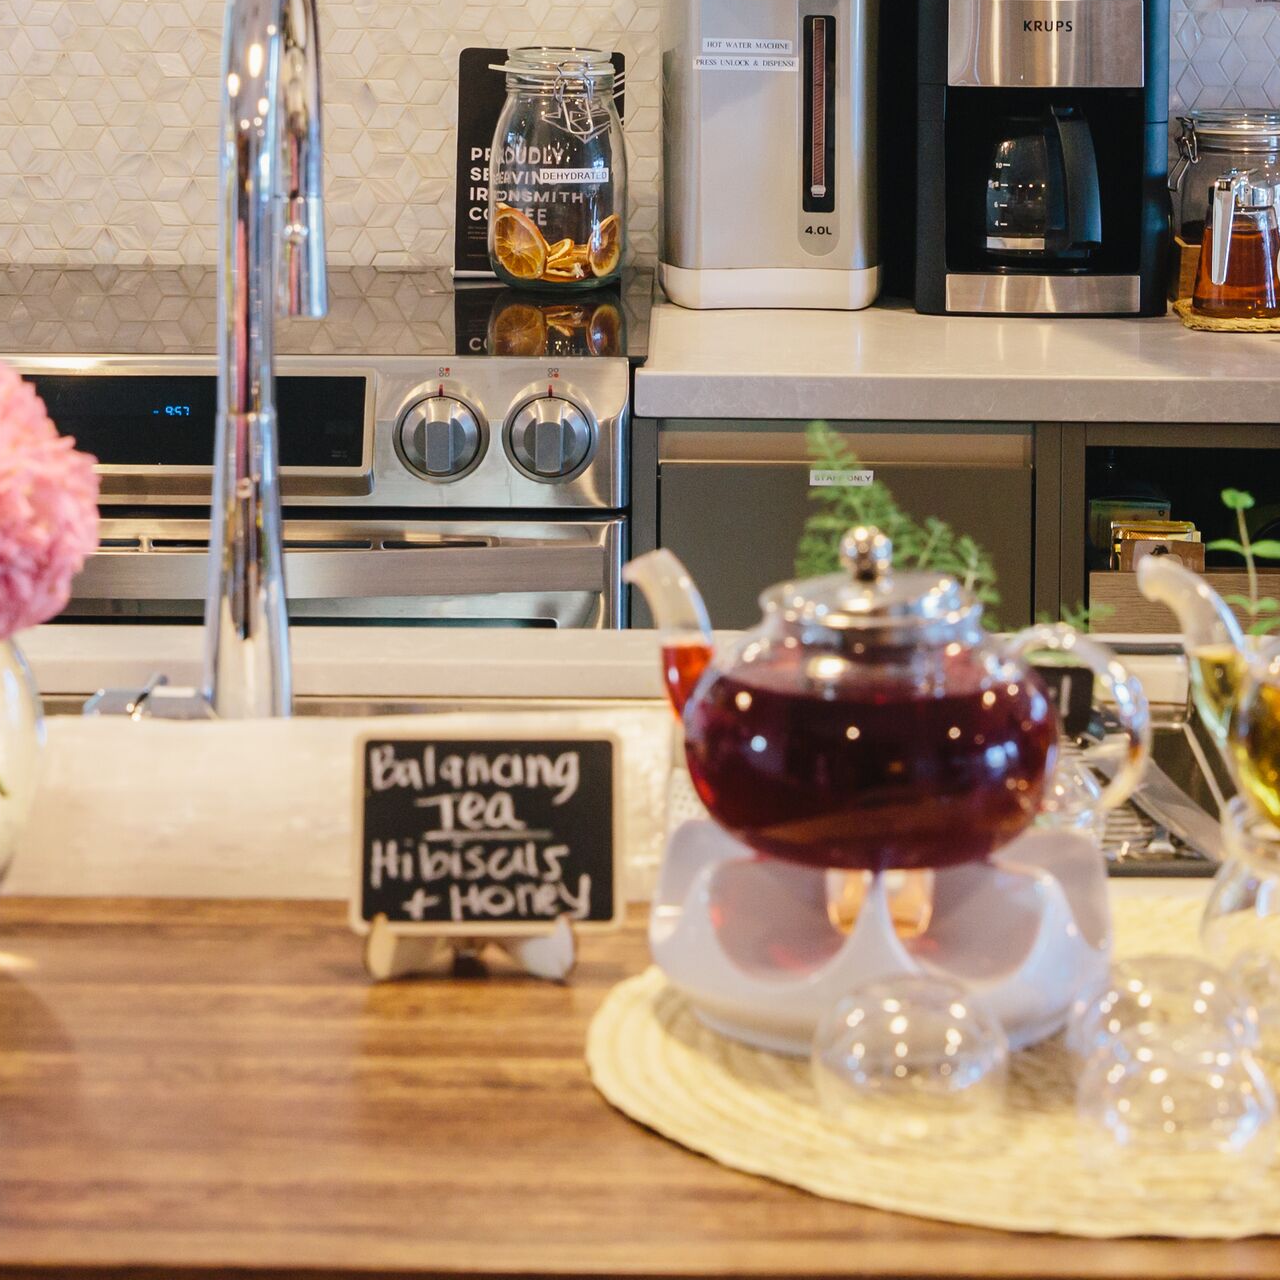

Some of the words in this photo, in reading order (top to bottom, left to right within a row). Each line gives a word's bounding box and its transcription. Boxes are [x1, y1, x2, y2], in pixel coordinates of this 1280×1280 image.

[1023, 20, 1072, 32] KRUPS
[726, 41, 752, 49] WATER
[756, 42, 789, 50] MACHINE
[720, 59, 750, 67] UNLOCK
[542, 172, 607, 181] DEHYDRATED
[805, 226, 832, 235] 4.0L
[414, 791, 526, 831] Tea
[370, 838, 569, 889] Hibiscus
[450, 873, 592, 921] Honey
